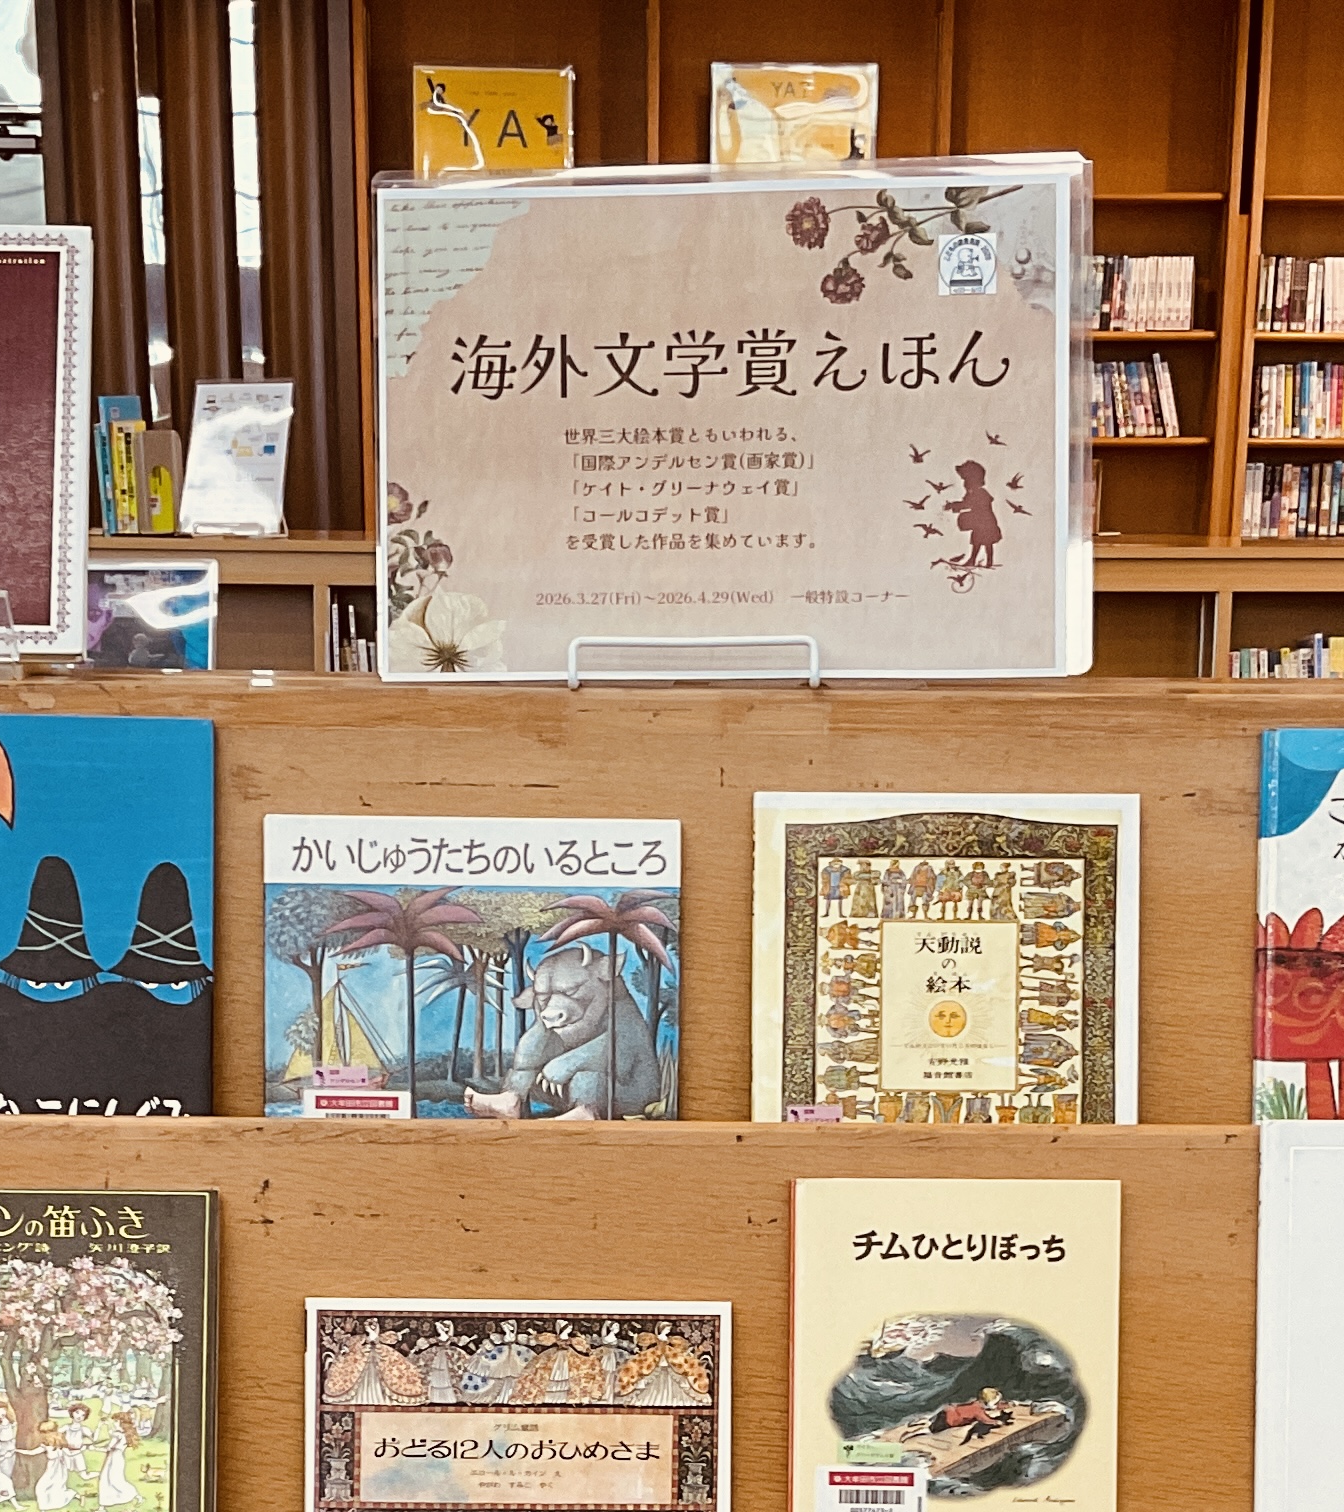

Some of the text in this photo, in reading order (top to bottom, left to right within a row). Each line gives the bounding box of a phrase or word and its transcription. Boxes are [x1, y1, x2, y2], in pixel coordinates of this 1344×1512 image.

[450, 330, 1010, 399] 海外文学賞えほん
[564, 427, 798, 446] 世界三大絵本賞ともいわれる、
[572, 479, 799, 497] 「ケイト・グリーナウェイ賞」
[566, 532, 817, 551] を受賞した作品を集めています。
[790, 590, 909, 605] 一般特設コーナー
[291, 836, 667, 877] かいじゅうたちのいるところ
[914, 936, 983, 955] 天動説
[941, 958, 957, 969] の
[925, 975, 972, 994] 絵本
[851, 1229, 1067, 1263] チムひとりぼっち
[373, 1437, 661, 1462] おどる12人のおひめさま
